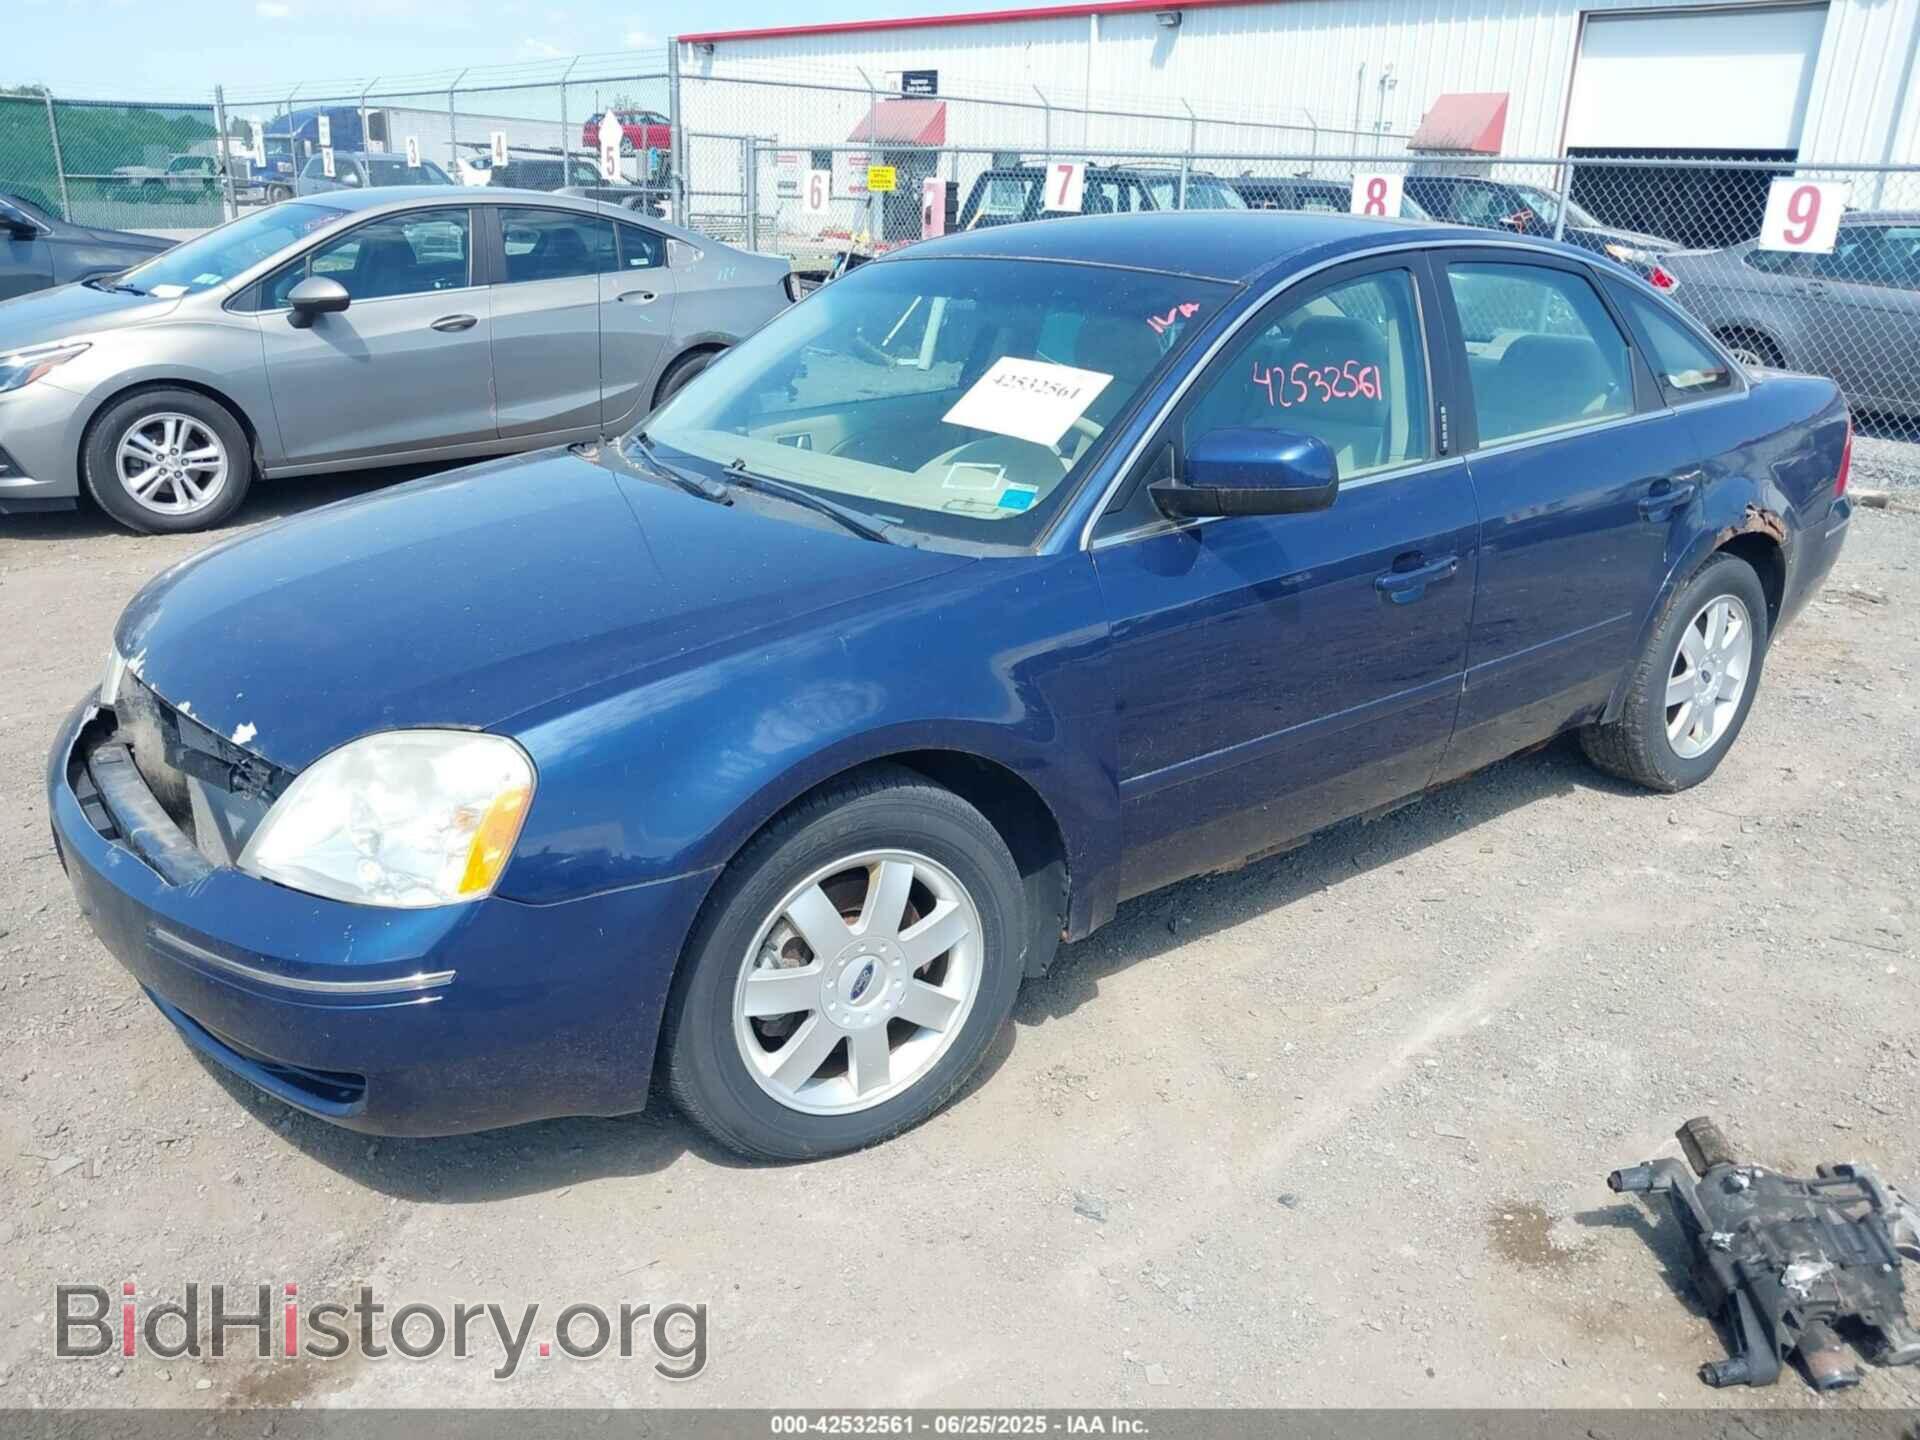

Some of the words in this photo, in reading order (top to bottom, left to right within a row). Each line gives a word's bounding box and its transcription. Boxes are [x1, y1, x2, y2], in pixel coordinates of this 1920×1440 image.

[325, 150, 333, 174] 2
[408, 138, 416, 164] 3
[606, 146, 615, 176] 5
[810, 174, 822, 210] 6
[1056, 164, 1074, 206] 7
[1364, 177, 1387, 216] 8
[1783, 184, 1822, 246] 9
[1252, 360, 1383, 408] 42532561
